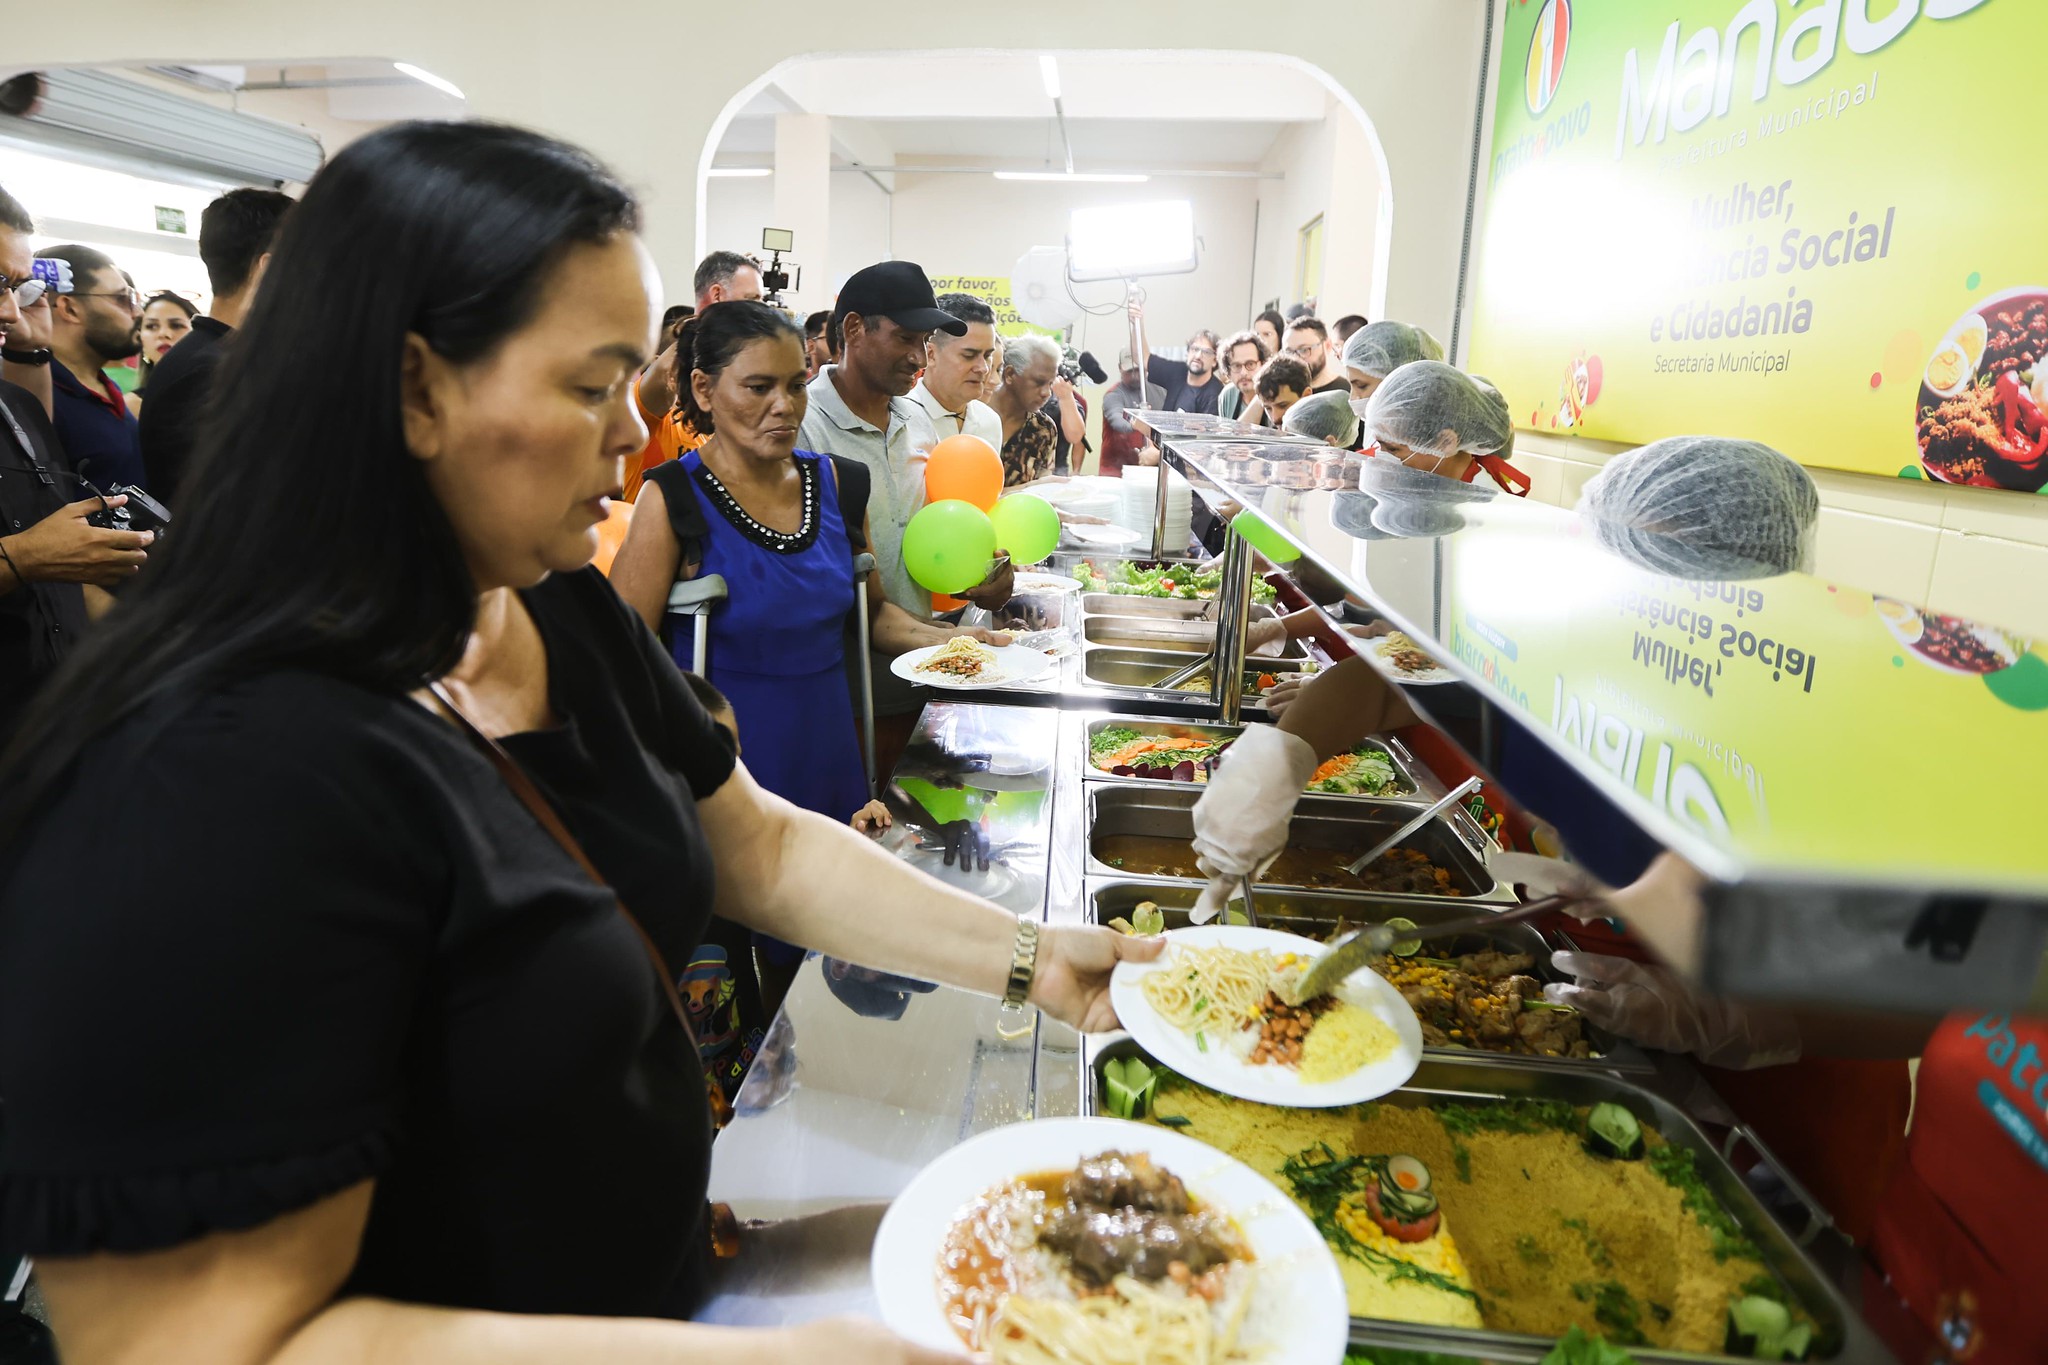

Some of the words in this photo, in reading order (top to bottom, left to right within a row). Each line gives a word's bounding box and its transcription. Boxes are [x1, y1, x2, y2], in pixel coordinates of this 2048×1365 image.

[1658, 128, 1748, 176] Prefeitura
[1757, 71, 1879, 141] Municipal
[1687, 179, 1794, 231] Mulher,
[1776, 206, 1896, 274] Social
[956, 277, 998, 292] favor,
[1650, 314, 1664, 342] e
[1669, 286, 1813, 342] Cidadania
[1654, 353, 1714, 374] Secretaria
[1717, 350, 1791, 377] Municipal
